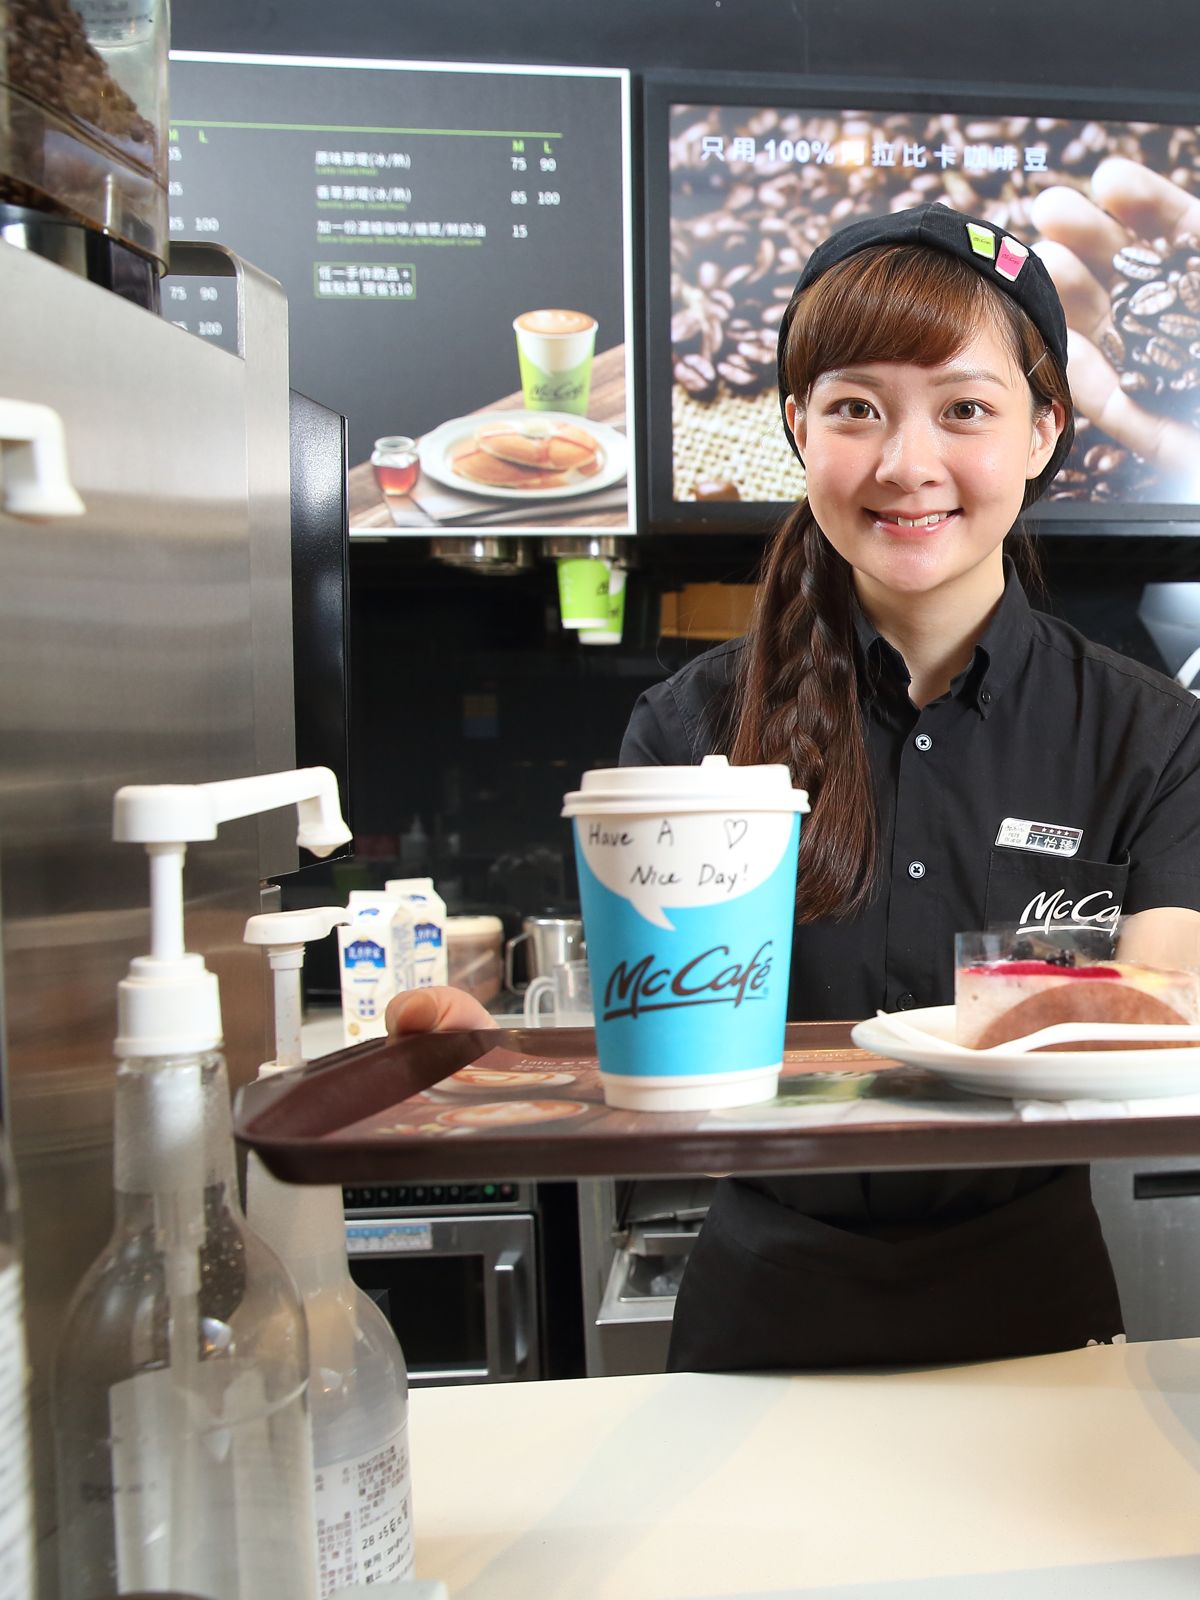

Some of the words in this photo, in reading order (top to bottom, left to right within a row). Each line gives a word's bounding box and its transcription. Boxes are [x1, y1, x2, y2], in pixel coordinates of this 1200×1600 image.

[511, 157, 527, 171] 75
[540, 158, 557, 172] 90
[511, 191, 528, 205] 85
[538, 192, 560, 206] 100
[512, 225, 528, 239] 15
[588, 823, 635, 847] Have
[657, 819, 675, 846] A
[630, 864, 683, 886] Nice
[698, 863, 749, 893] Day!
[603, 939, 774, 1021] McCafé
